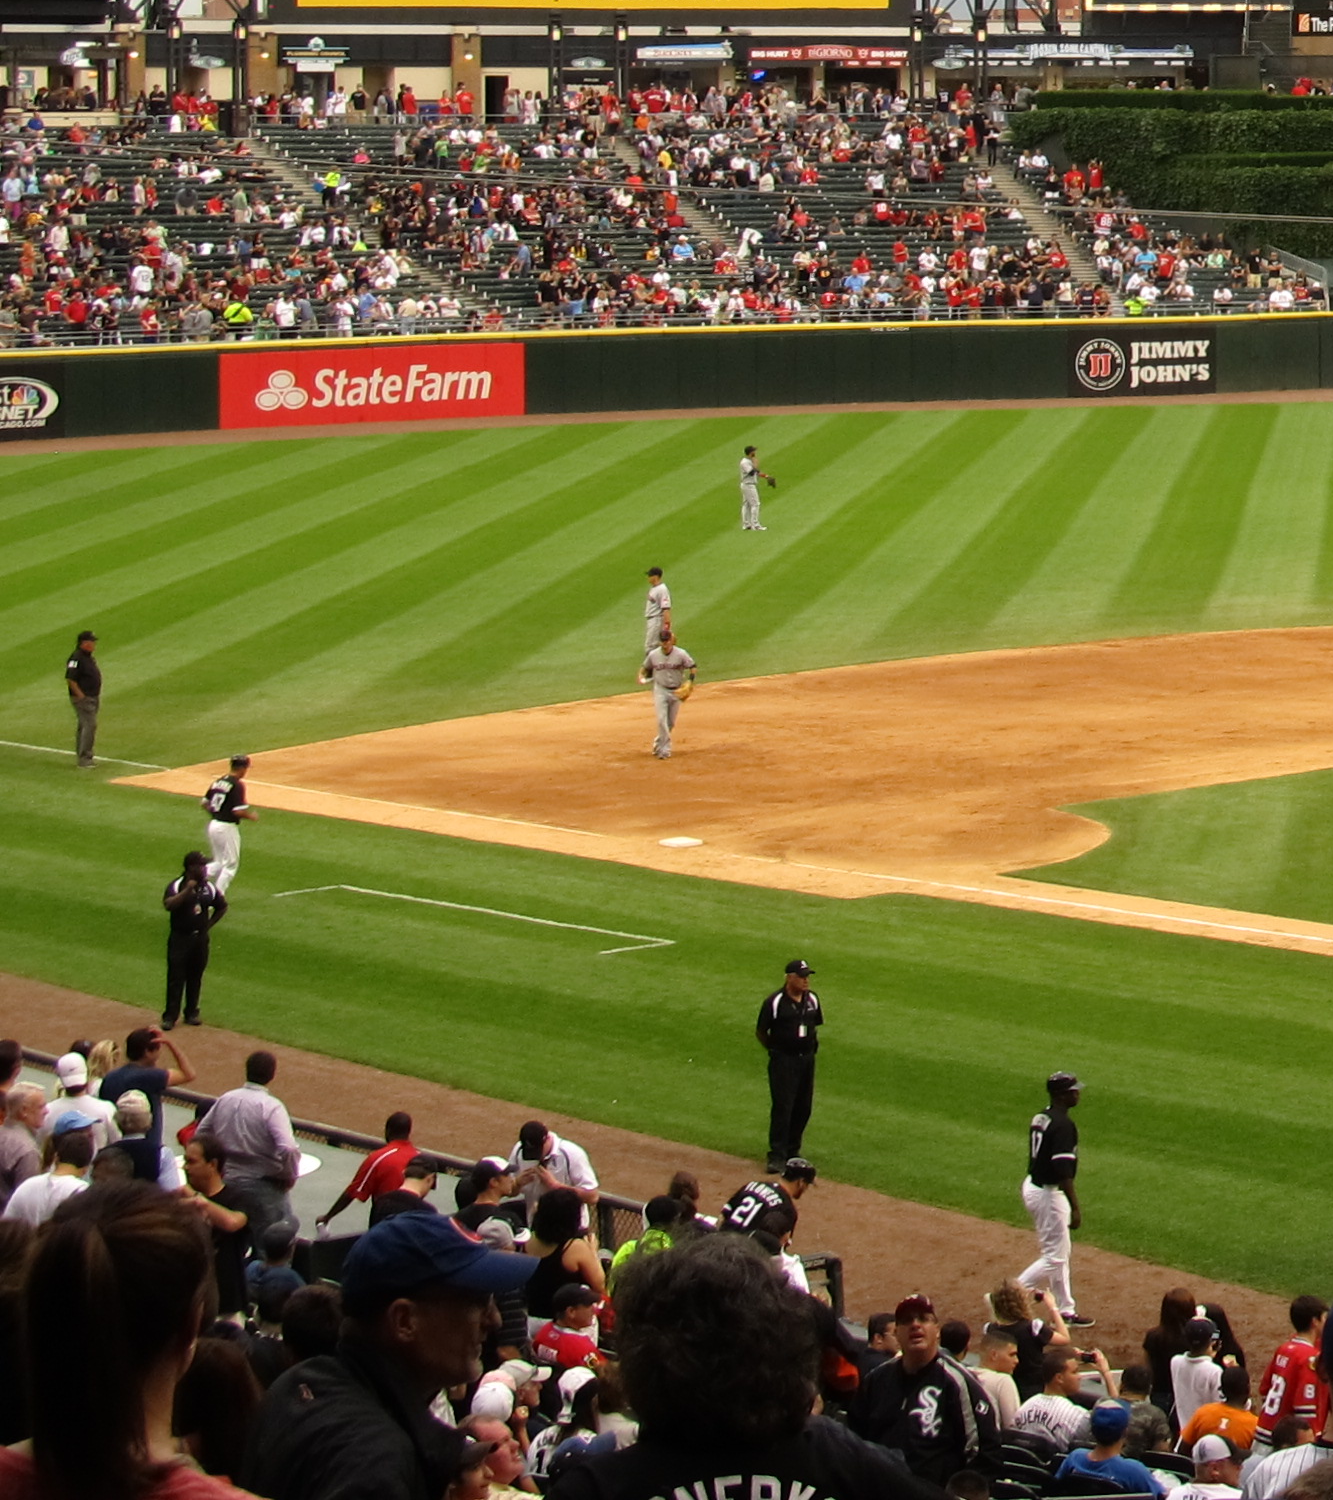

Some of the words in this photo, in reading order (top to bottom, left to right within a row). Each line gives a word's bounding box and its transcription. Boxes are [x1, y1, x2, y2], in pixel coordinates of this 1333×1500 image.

[1311, 16, 1328, 33] The
[1130, 340, 1210, 364] JIMMY
[1089, 353, 1112, 378] JJ
[1130, 364, 1210, 388] JOHN'S
[730, 1196, 764, 1227] 21
